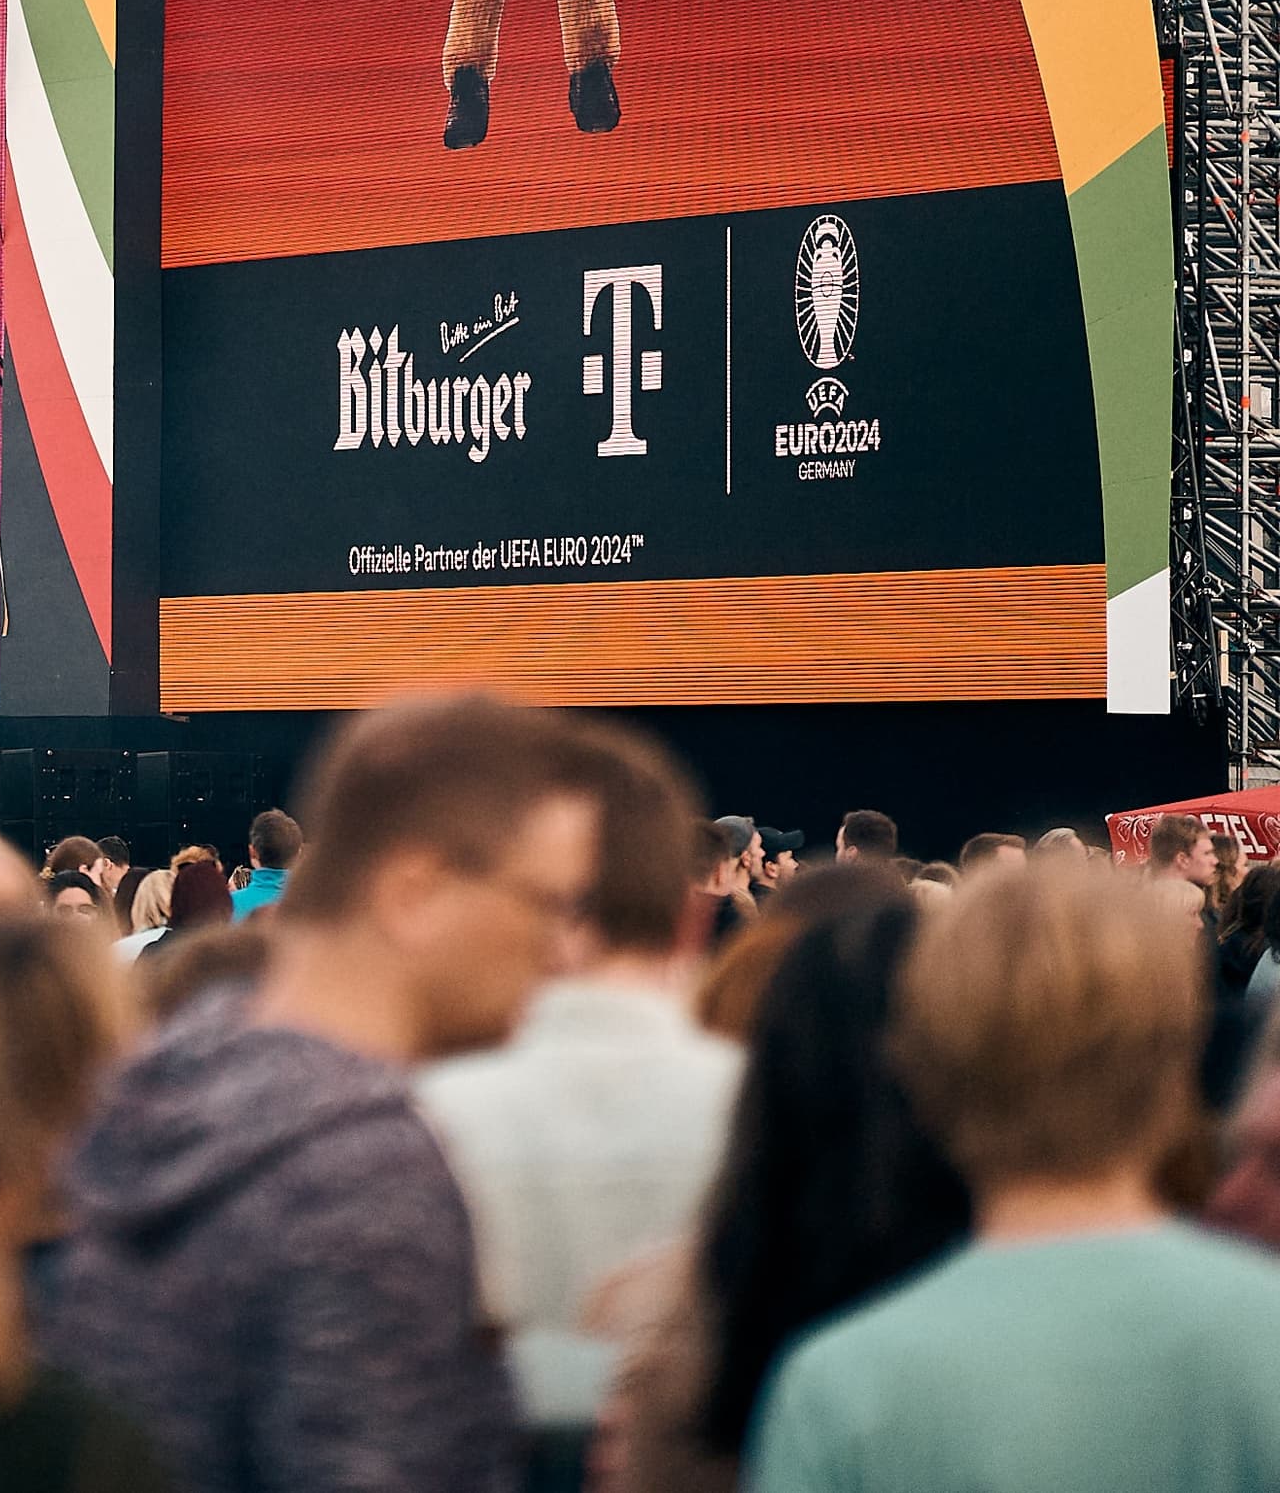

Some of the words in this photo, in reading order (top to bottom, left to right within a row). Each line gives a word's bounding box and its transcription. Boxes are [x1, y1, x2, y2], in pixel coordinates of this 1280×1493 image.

[333, 323, 532, 463] Bitburger
[807, 383, 846, 412] UEFA
[798, 459, 857, 481] GERMANY
[348, 545, 411, 575] Offizielle
[414, 543, 468, 572] Partner
[472, 541, 498, 570] der
[500, 539, 541, 569] UEFA
[543, 536, 588, 567] EURO
